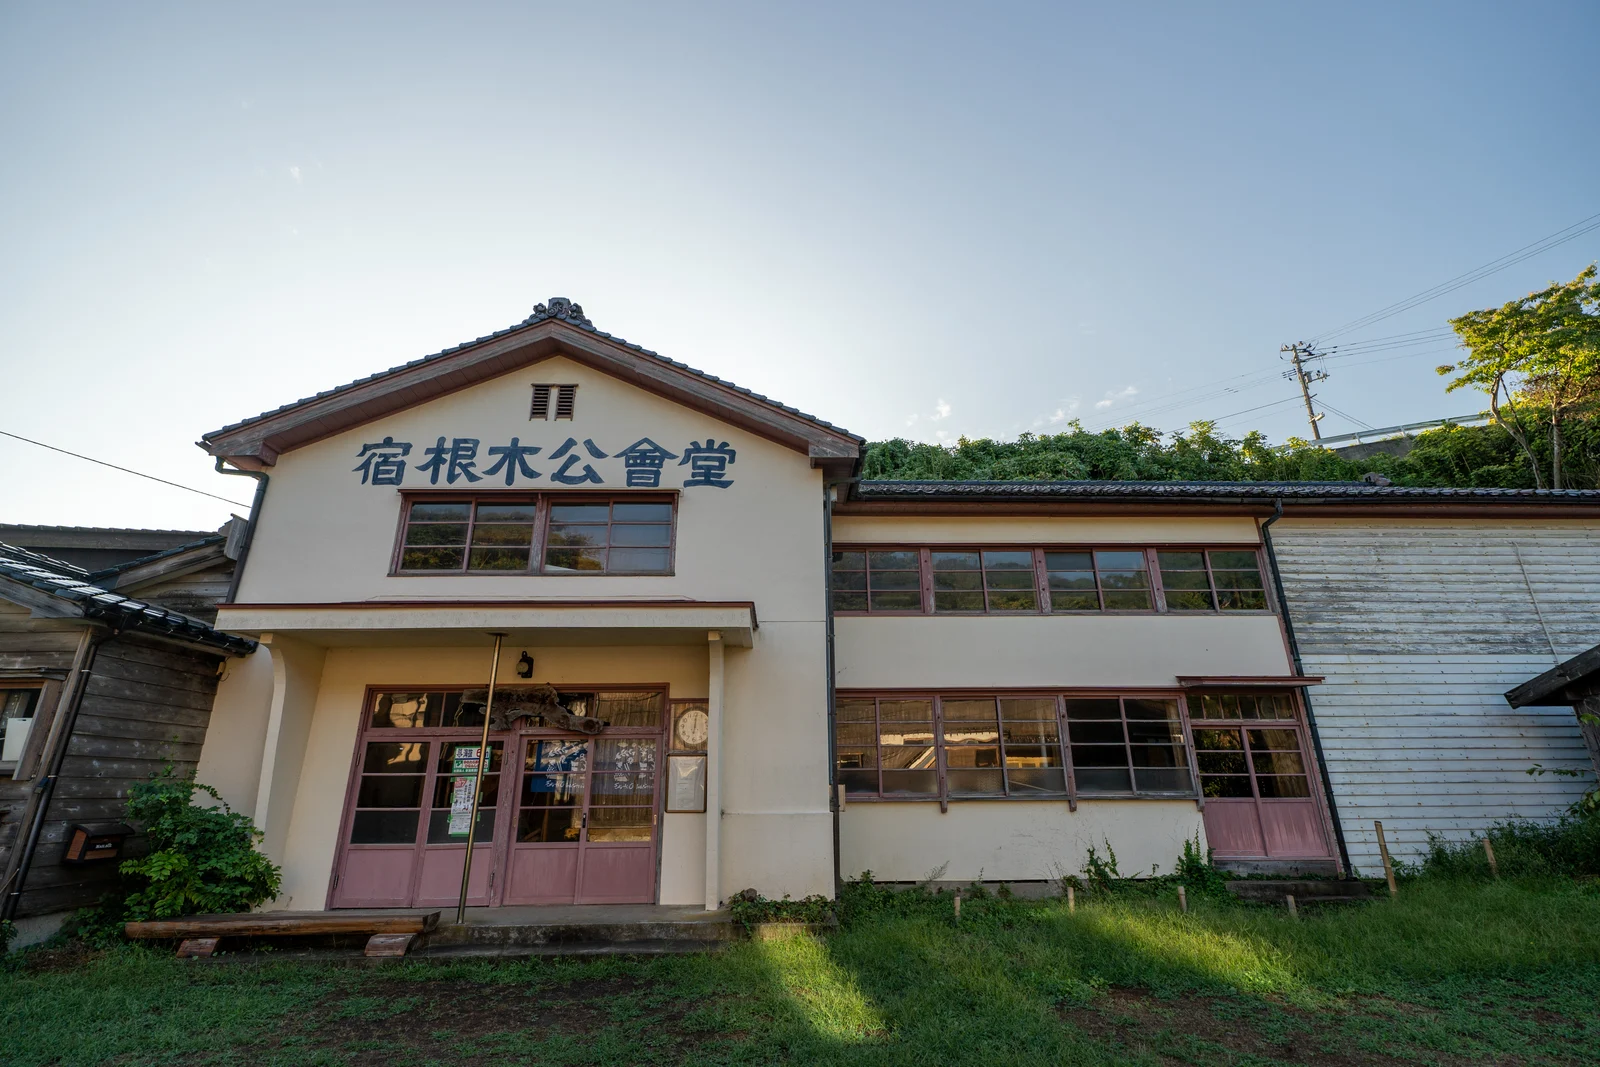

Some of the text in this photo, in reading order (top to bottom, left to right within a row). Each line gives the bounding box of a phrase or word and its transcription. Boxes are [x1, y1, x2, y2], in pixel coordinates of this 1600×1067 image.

[351, 436, 737, 489] 宿根木公會堂
